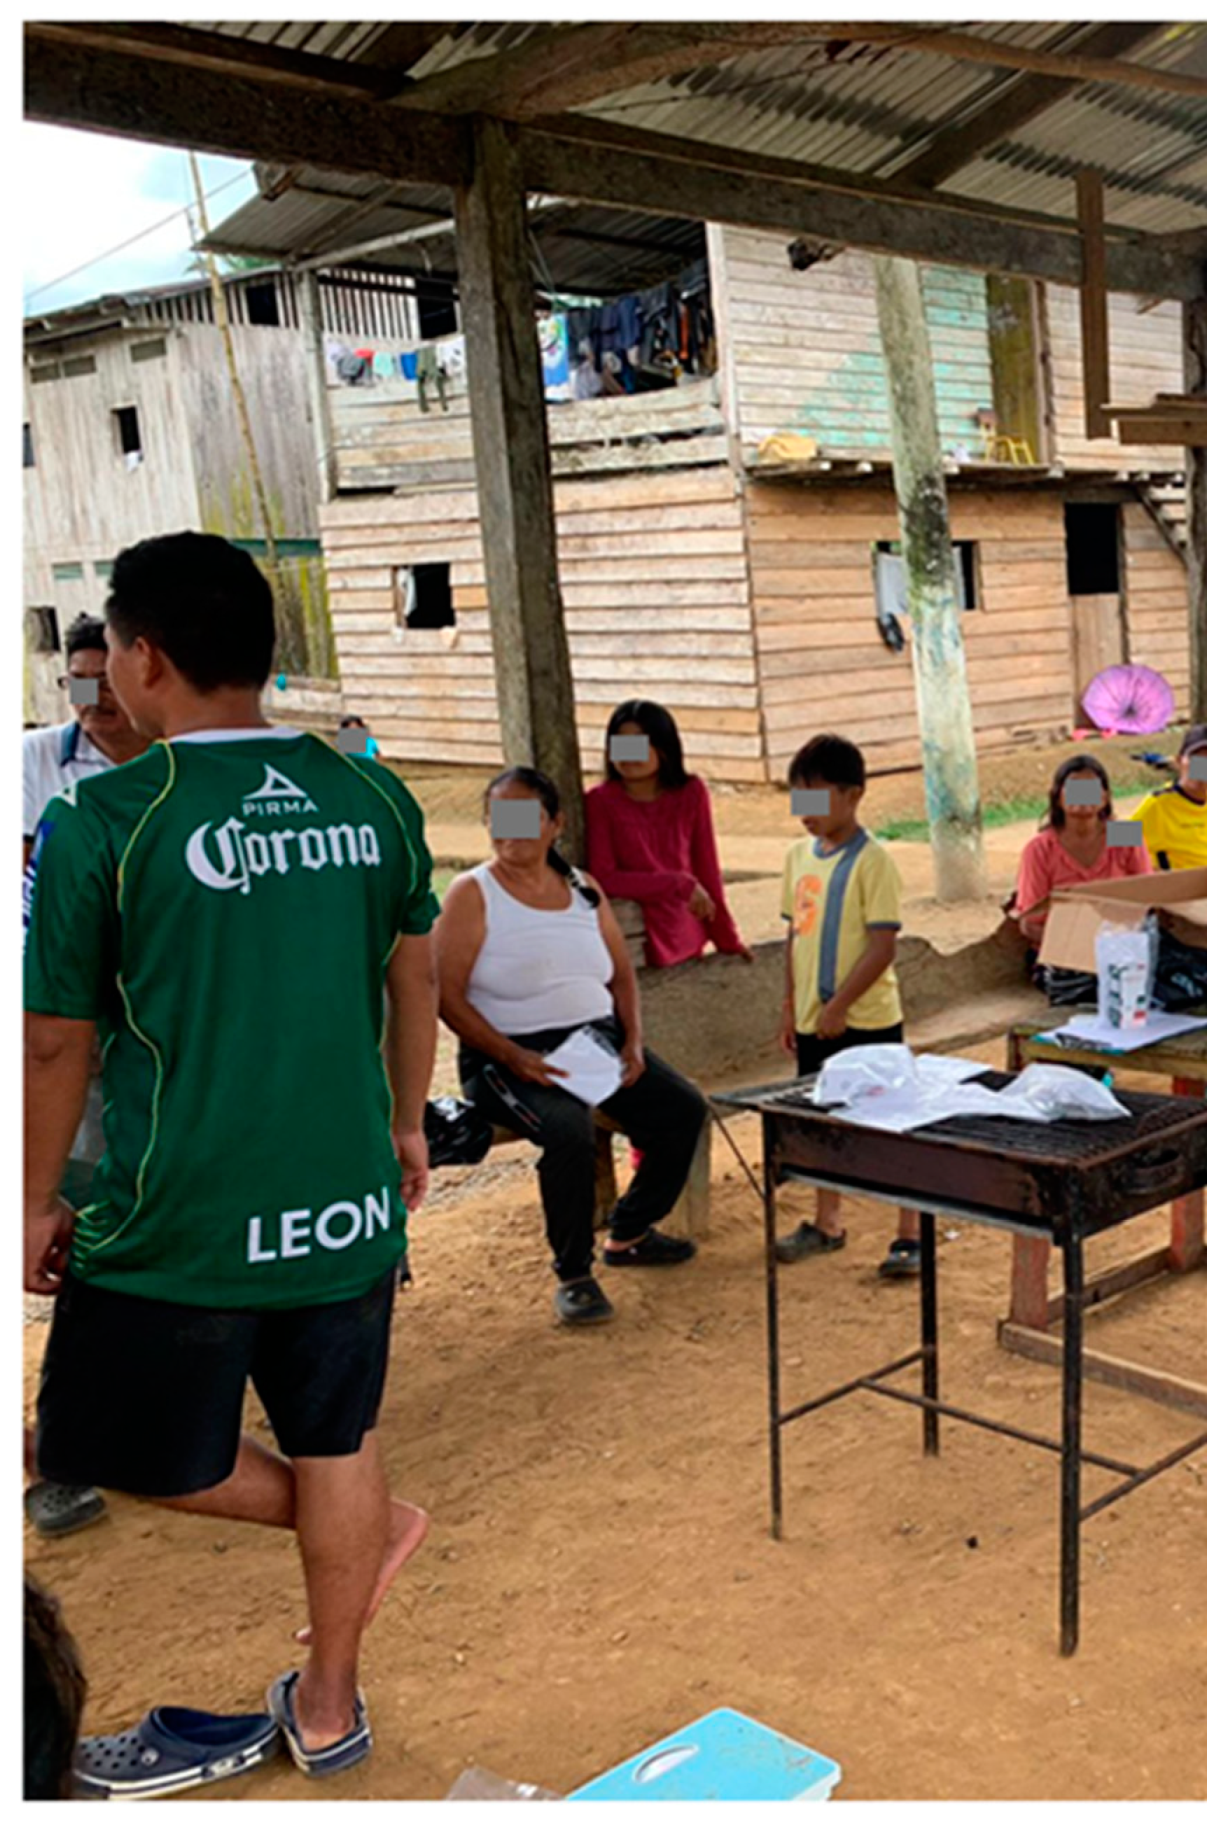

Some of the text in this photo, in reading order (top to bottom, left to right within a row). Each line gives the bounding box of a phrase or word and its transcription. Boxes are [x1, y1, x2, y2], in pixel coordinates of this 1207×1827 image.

[243, 800, 318, 816] PIRMA
[186, 816, 380, 895] Corona
[247, 1186, 390, 1263] LEON
